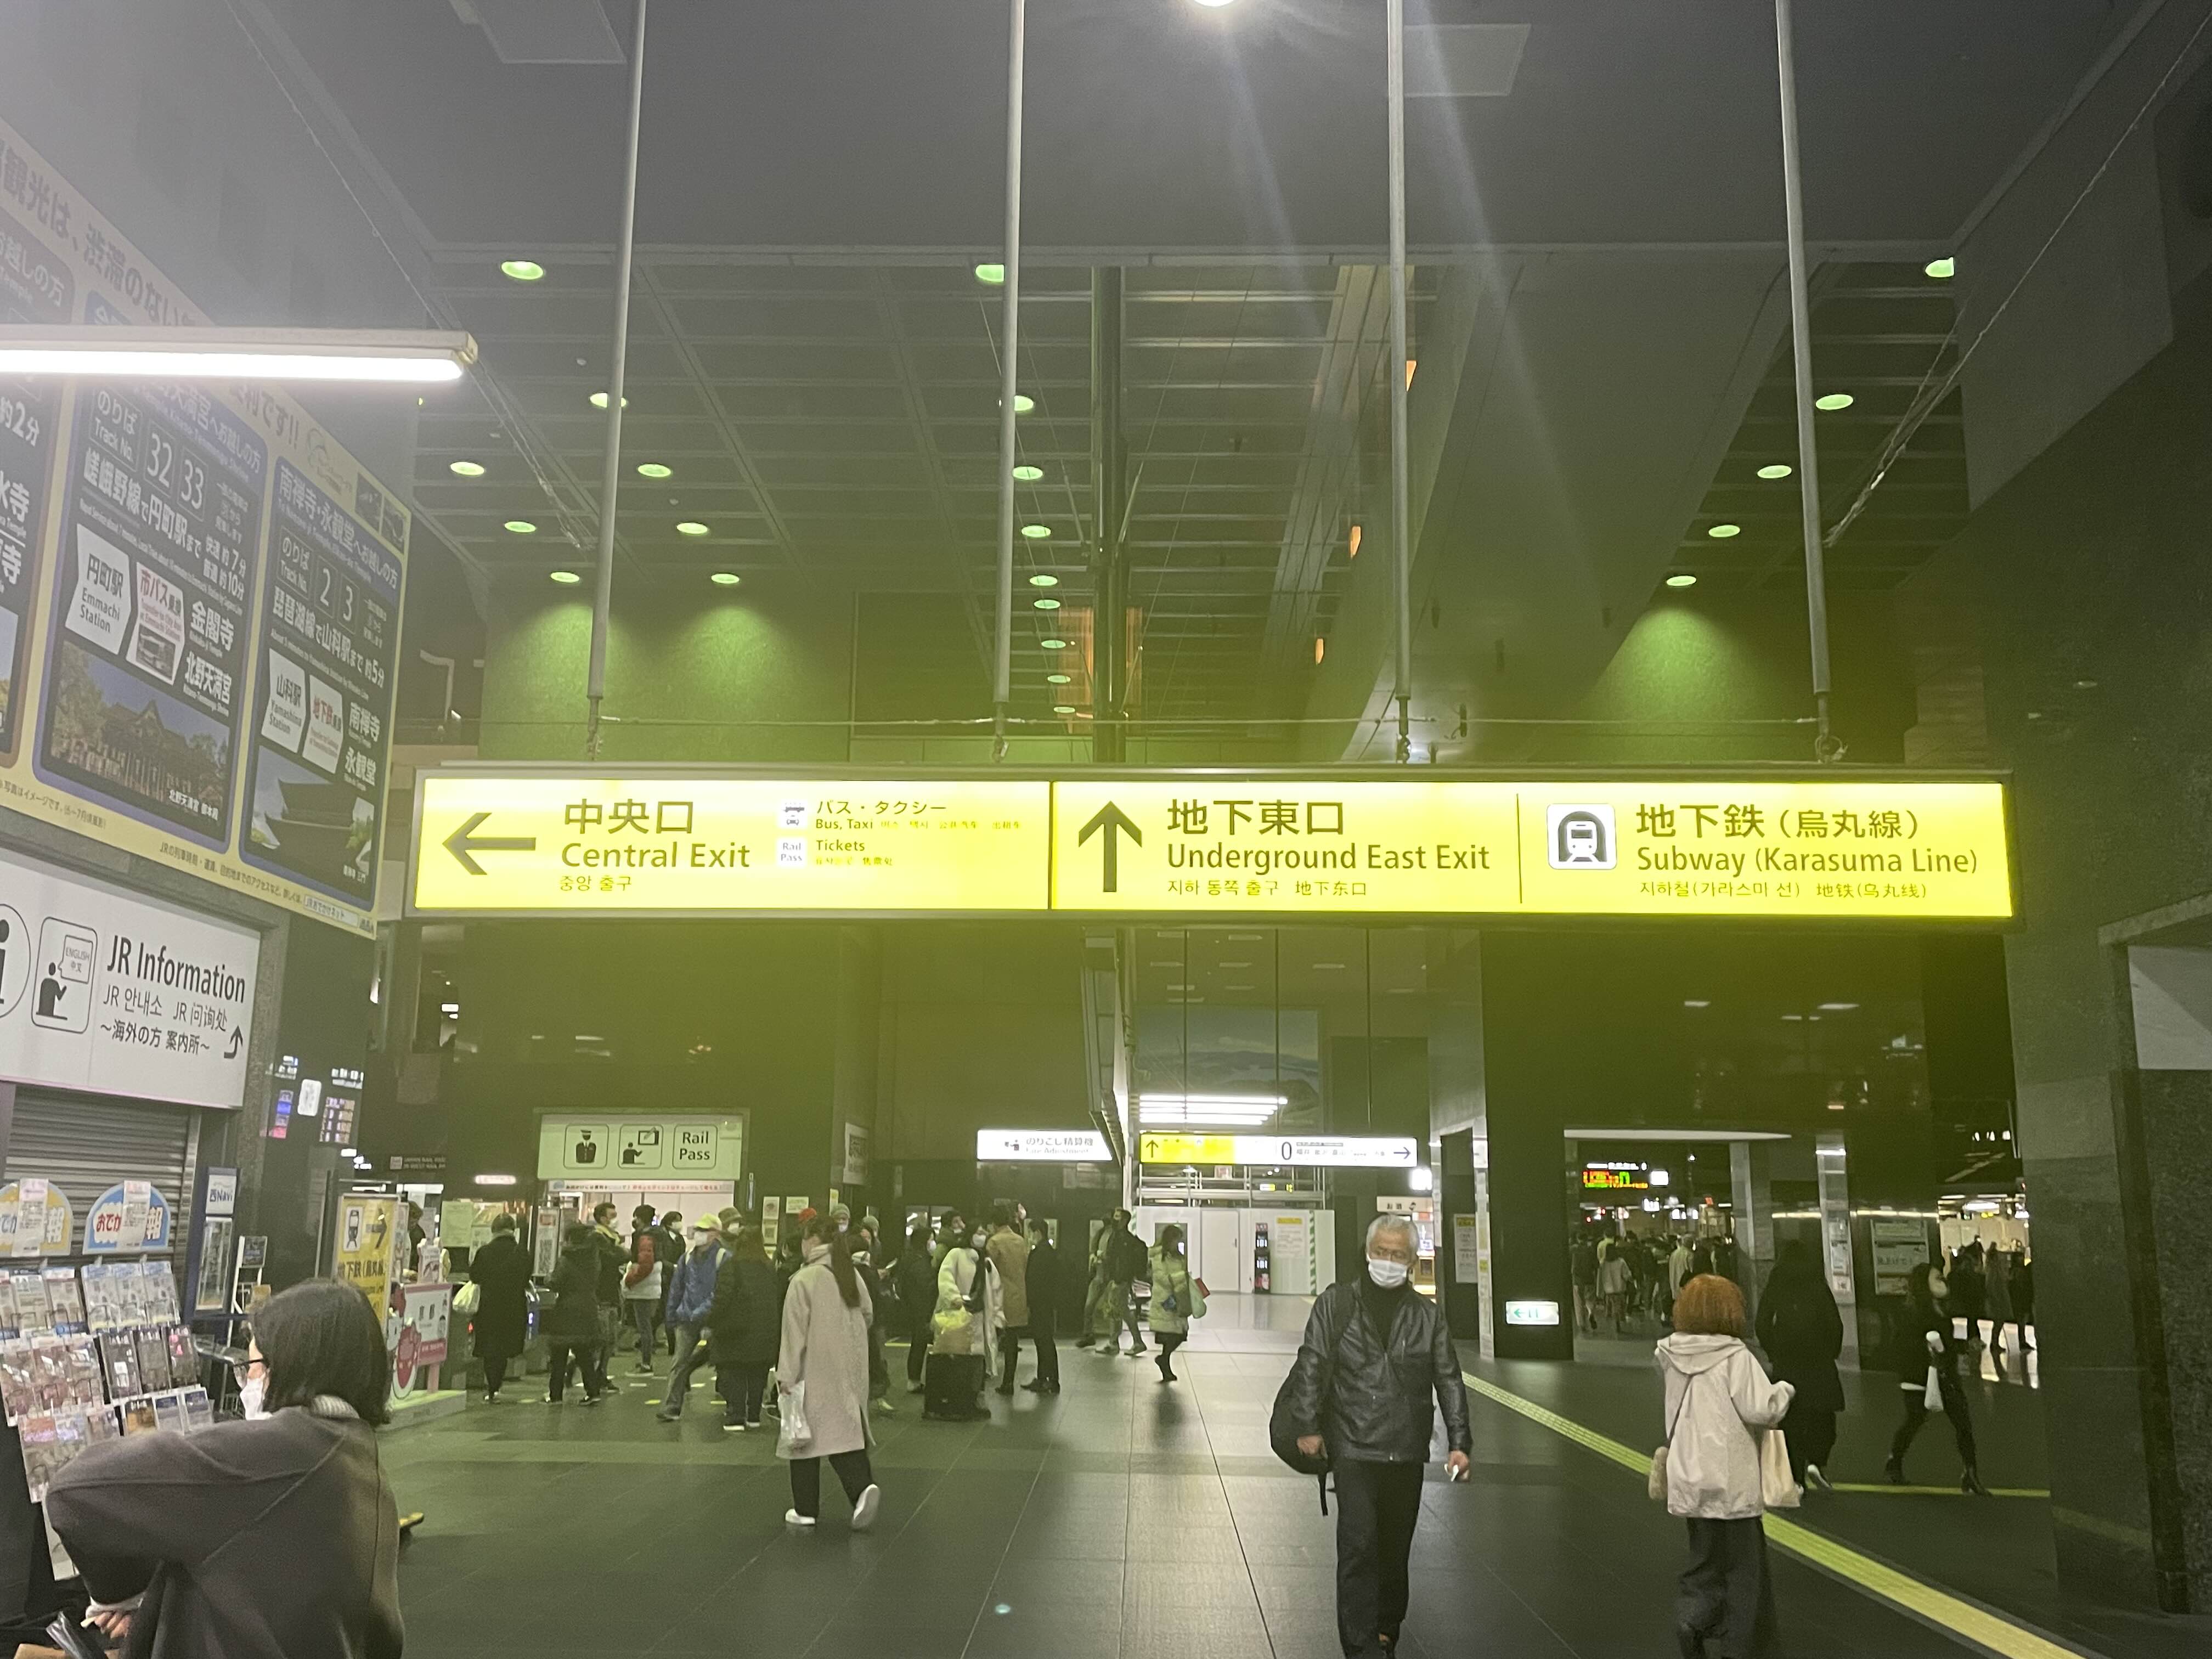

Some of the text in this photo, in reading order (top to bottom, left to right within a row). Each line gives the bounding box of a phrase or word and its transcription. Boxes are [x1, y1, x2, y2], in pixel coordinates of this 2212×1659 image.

[97, 390, 138, 435] のりば
[95, 417, 119, 450] Track
[147, 433, 172, 488] 32
[181, 459, 204, 510] 33
[282, 538, 311, 570] のりば
[87, 553, 123, 599] 円町駅
[320, 568, 330, 606] 2
[80, 605, 110, 633] Station
[82, 587, 120, 621] Emmachi
[342, 585, 353, 621] 3
[191, 601, 234, 651] 金閣寺
[185, 651, 232, 704] 北野天満宮
[276, 674, 302, 708] 山科駅
[349, 702, 381, 742] 南禅寺
[345, 746, 376, 786] 永観堂
[565, 799, 694, 835] 中央口
[817, 800, 947, 815] バス・タクシー
[1167, 799, 1344, 836] 地下東口
[816, 819, 873, 831] Bus, Taxi
[562, 842, 751, 868] Central Exit
[781, 854, 803, 862] Pass
[783, 843, 802, 851] Rail
[816, 839, 866, 852] Tickets
[1168, 842, 1491, 876] Underground East Exit
[1637, 845, 1977, 879] Subway (Karasuma Line)
[561, 876, 632, 892] 중앙 출구
[1169, 880, 1278, 896] 지하 동쪽 출구
[1295, 881, 1367, 896] 地下东口
[1816, 883, 1927, 899] 地铁(乌丸线)
[66, 947, 90, 961] ENGLISH
[107, 935, 245, 1003] JR Information
[103, 984, 162, 1017] JR 안내소
[173, 1001, 227, 1032] JR 问询处
[680, 1148, 710, 1160] Pass
[682, 1131, 708, 1144] Rail
